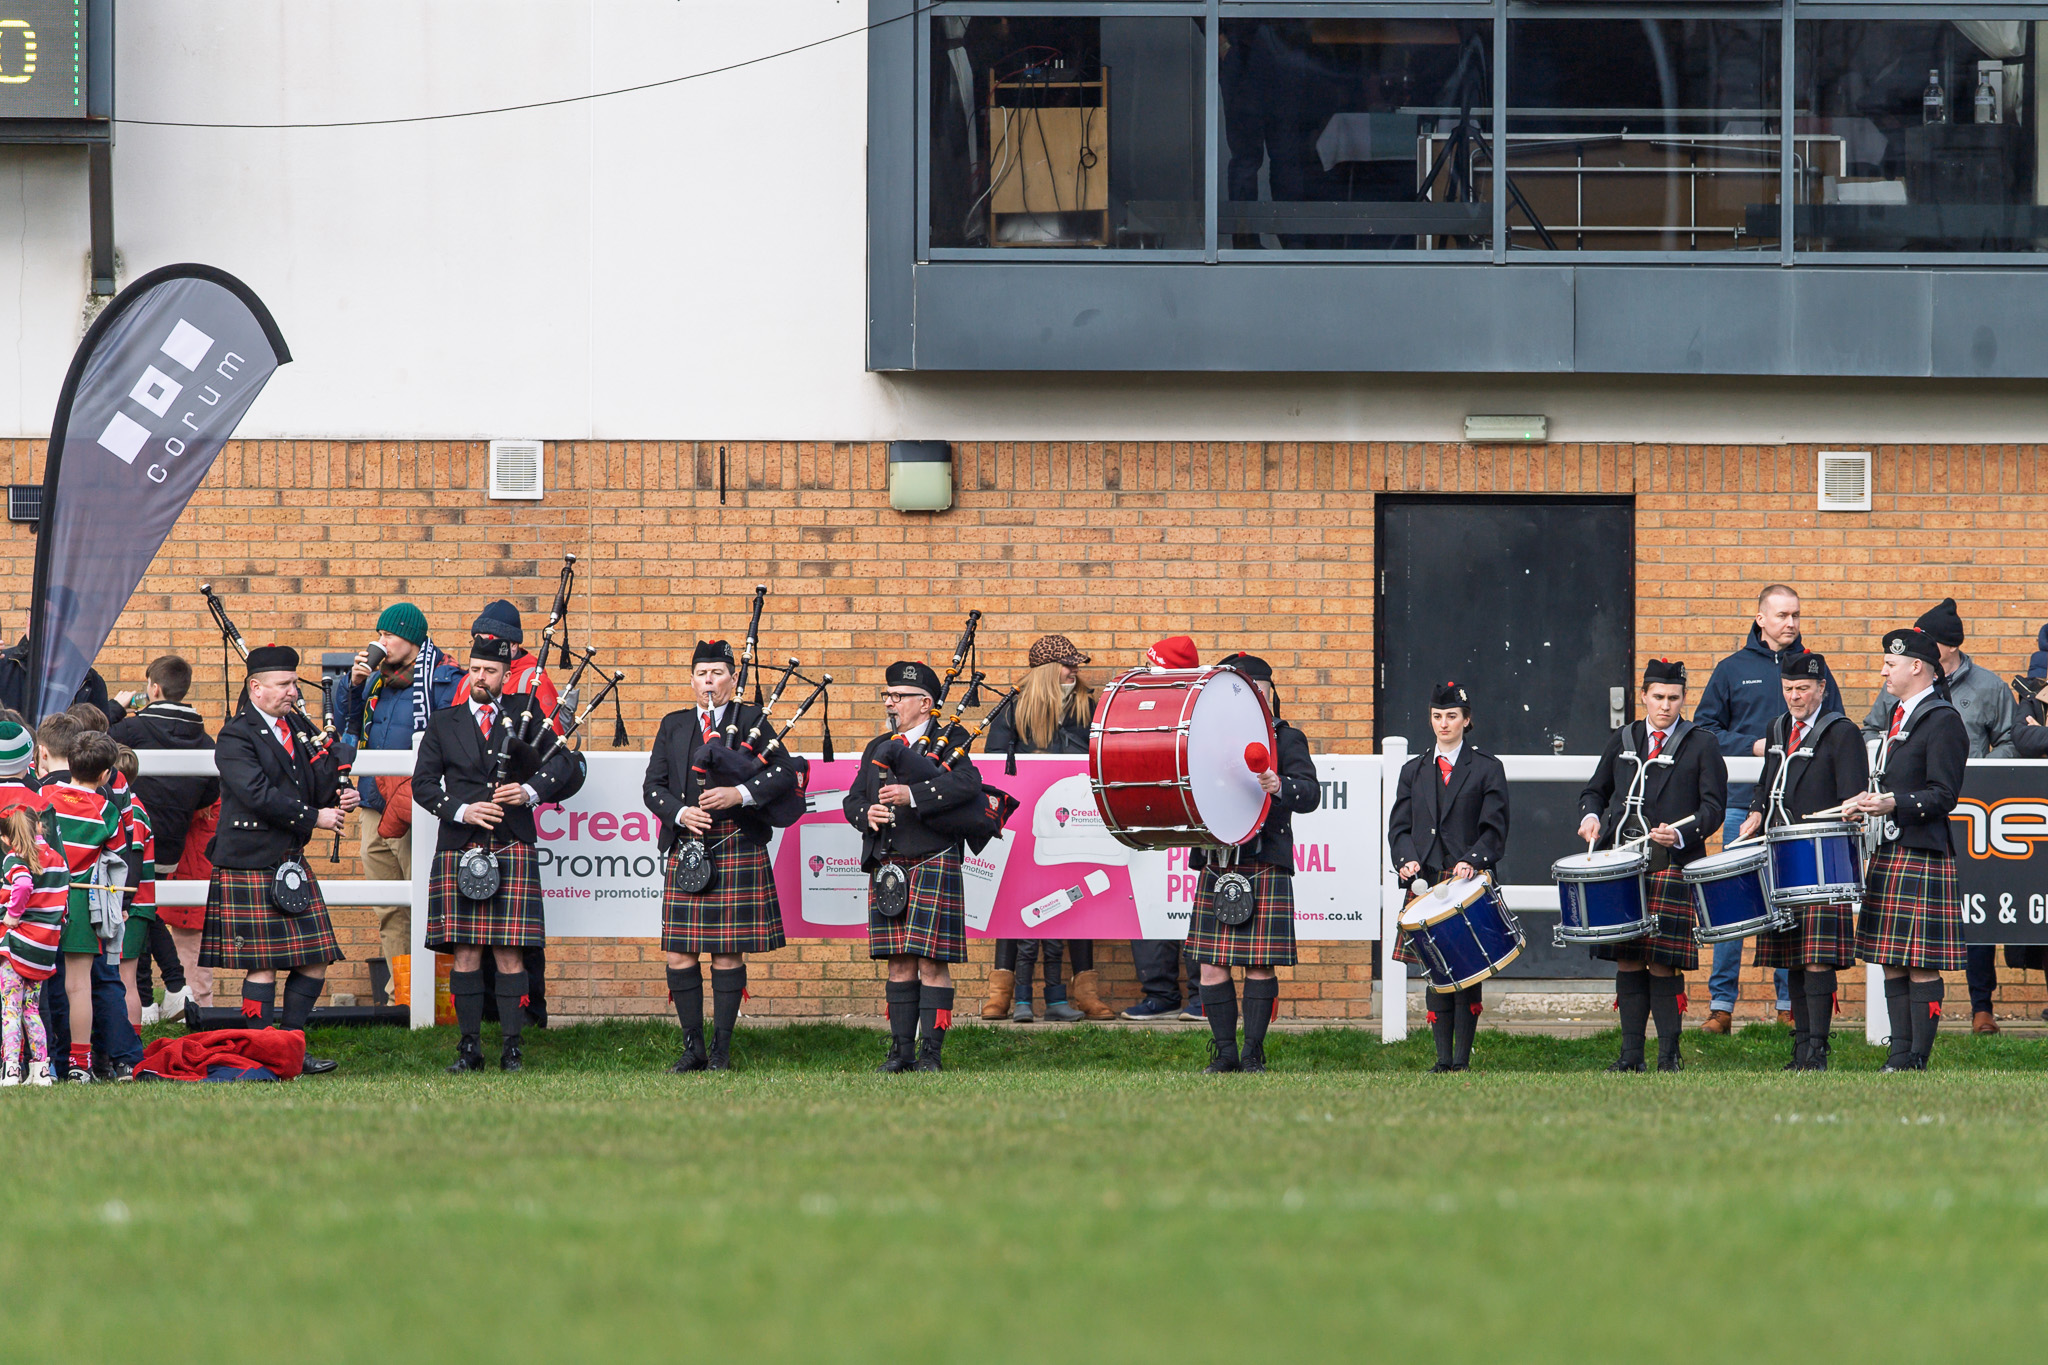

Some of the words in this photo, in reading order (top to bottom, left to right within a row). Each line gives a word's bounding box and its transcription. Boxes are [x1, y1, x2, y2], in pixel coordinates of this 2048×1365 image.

[147, 352, 245, 483] corum
[1320, 782, 1347, 809] TH
[963, 855, 996, 871] eative
[1999, 892, 2017, 924] &
[2029, 893, 2048, 924] G
